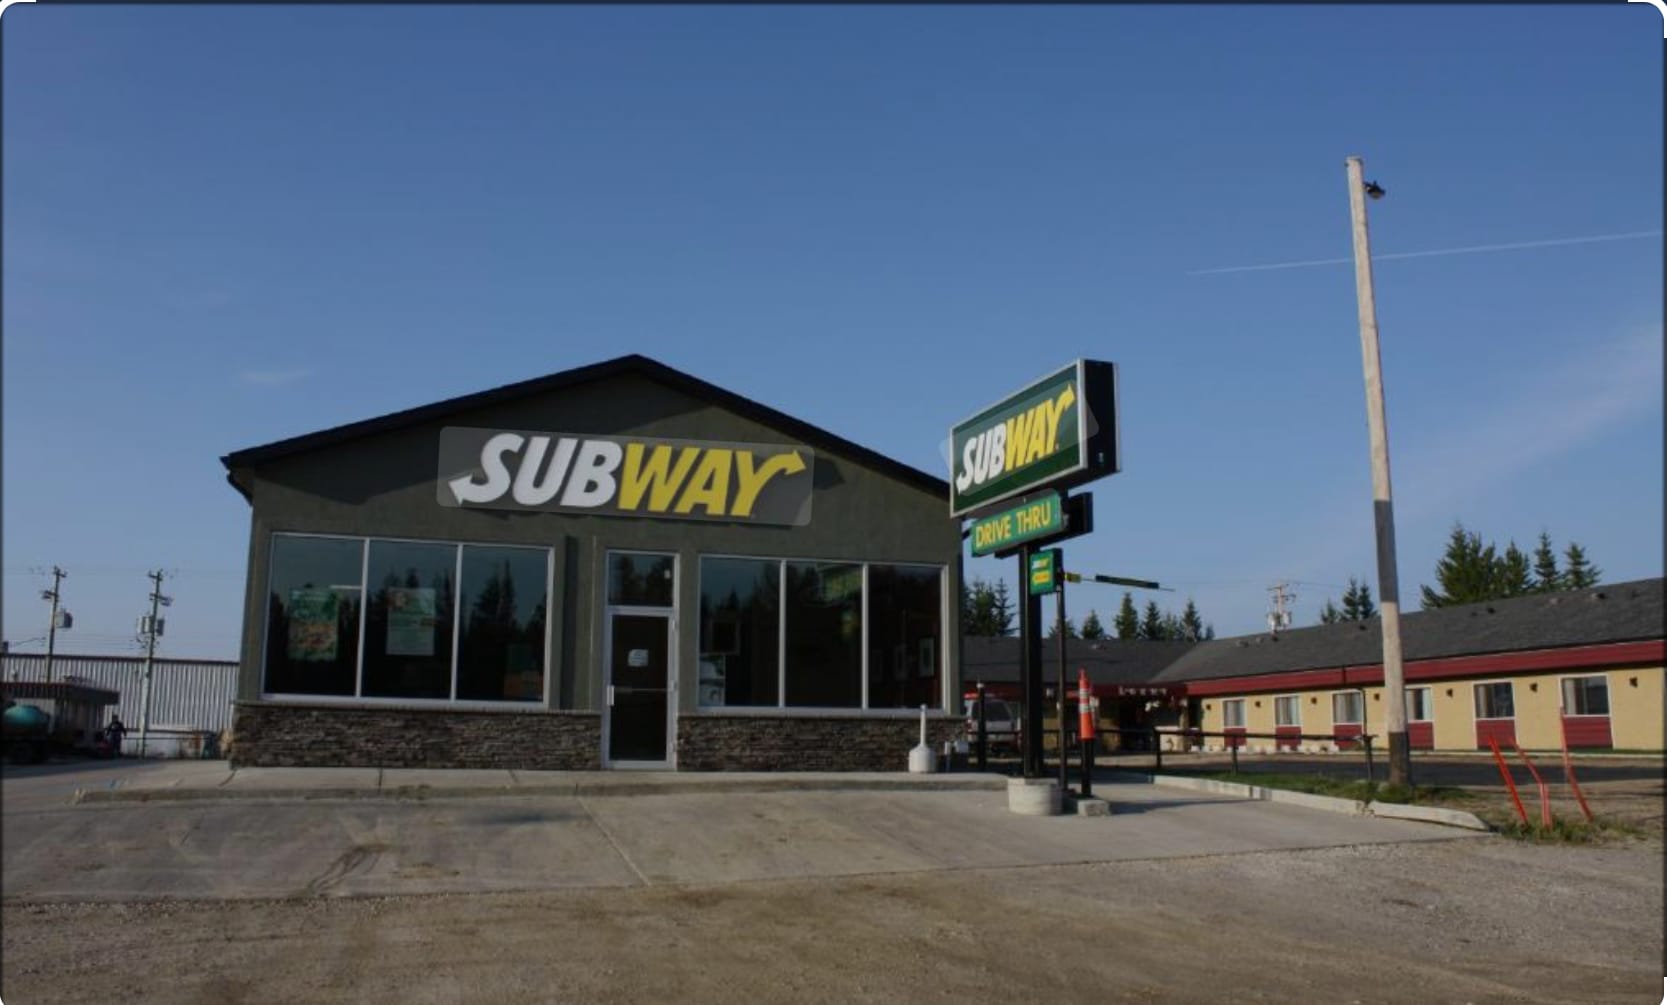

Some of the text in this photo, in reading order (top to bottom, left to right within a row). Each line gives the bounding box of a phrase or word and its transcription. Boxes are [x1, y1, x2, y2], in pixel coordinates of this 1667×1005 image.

[449, 433, 806, 517] SUBWAY
[957, 385, 1075, 494] SUBWAY
[975, 502, 1051, 548] DRIVE THRU
